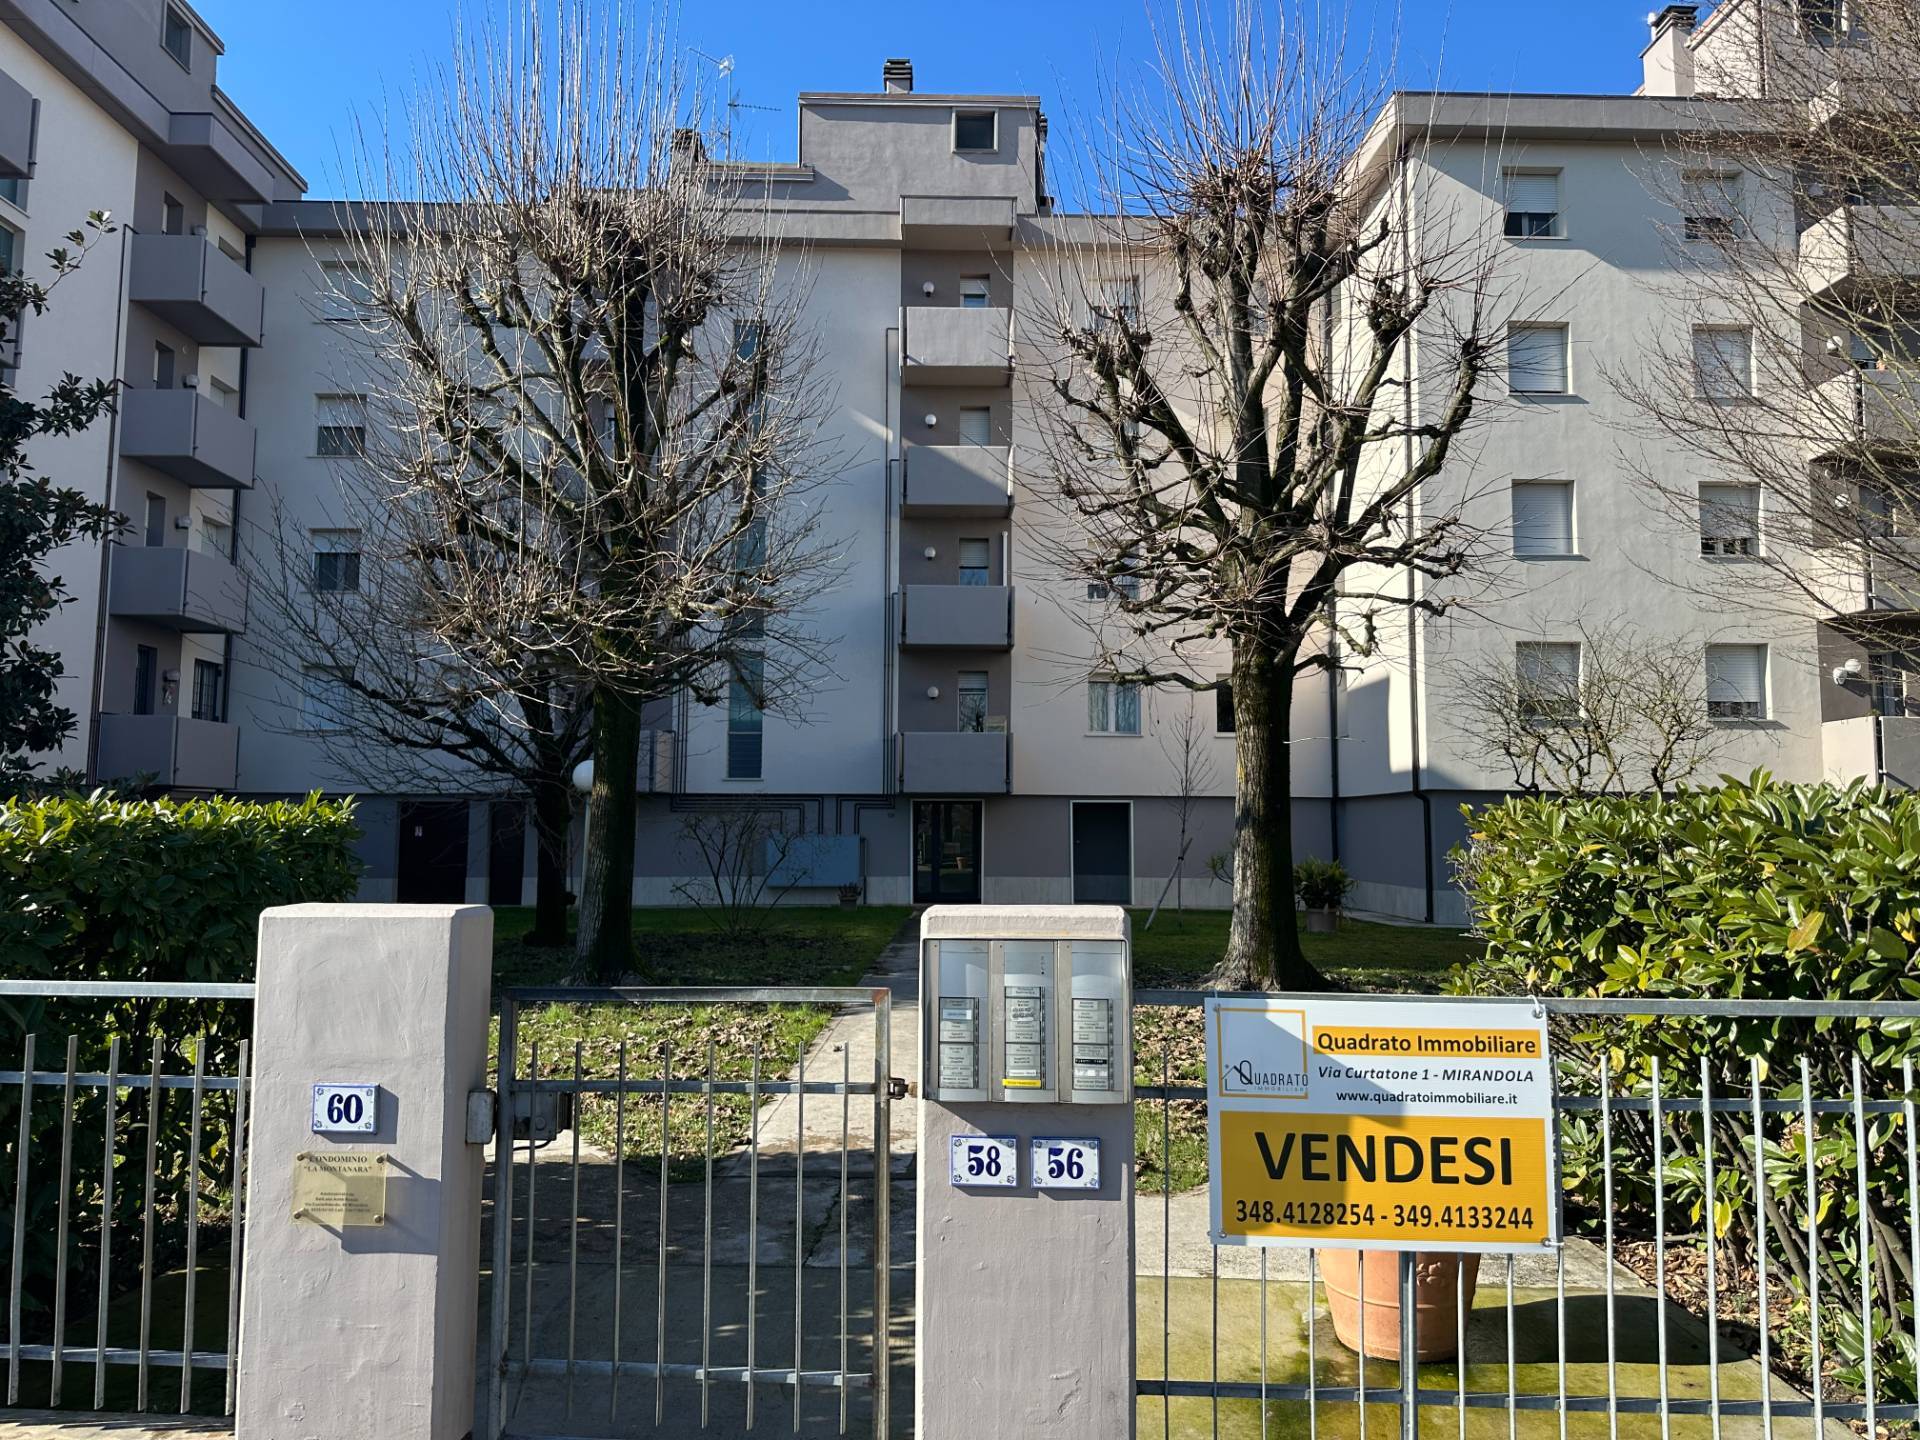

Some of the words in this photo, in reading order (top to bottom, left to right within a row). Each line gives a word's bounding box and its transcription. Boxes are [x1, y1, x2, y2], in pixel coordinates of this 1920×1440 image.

[1317, 1032, 1411, 1053] Quadrato
[1417, 1034, 1536, 1054] Immobiliare
[1236, 1060, 1309, 1087] QUADRATO
[1318, 1066, 1342, 1079] Via
[1345, 1067, 1418, 1080] Curtatone
[1422, 1069, 1429, 1080] 1
[1441, 1069, 1534, 1082] MIRANDOLA
[327, 1093, 364, 1124] 60
[1336, 1089, 1518, 1105] www.quadratoimmobiliare.it
[309, 1155, 368, 1164] CONDOMINIO
[967, 1145, 1002, 1177] 58
[1047, 1147, 1084, 1180] 56
[1254, 1132, 1512, 1186] VENDESI
[1236, 1200, 1375, 1226] 348.4128254
[1393, 1204, 1534, 1229] 349.4133244
